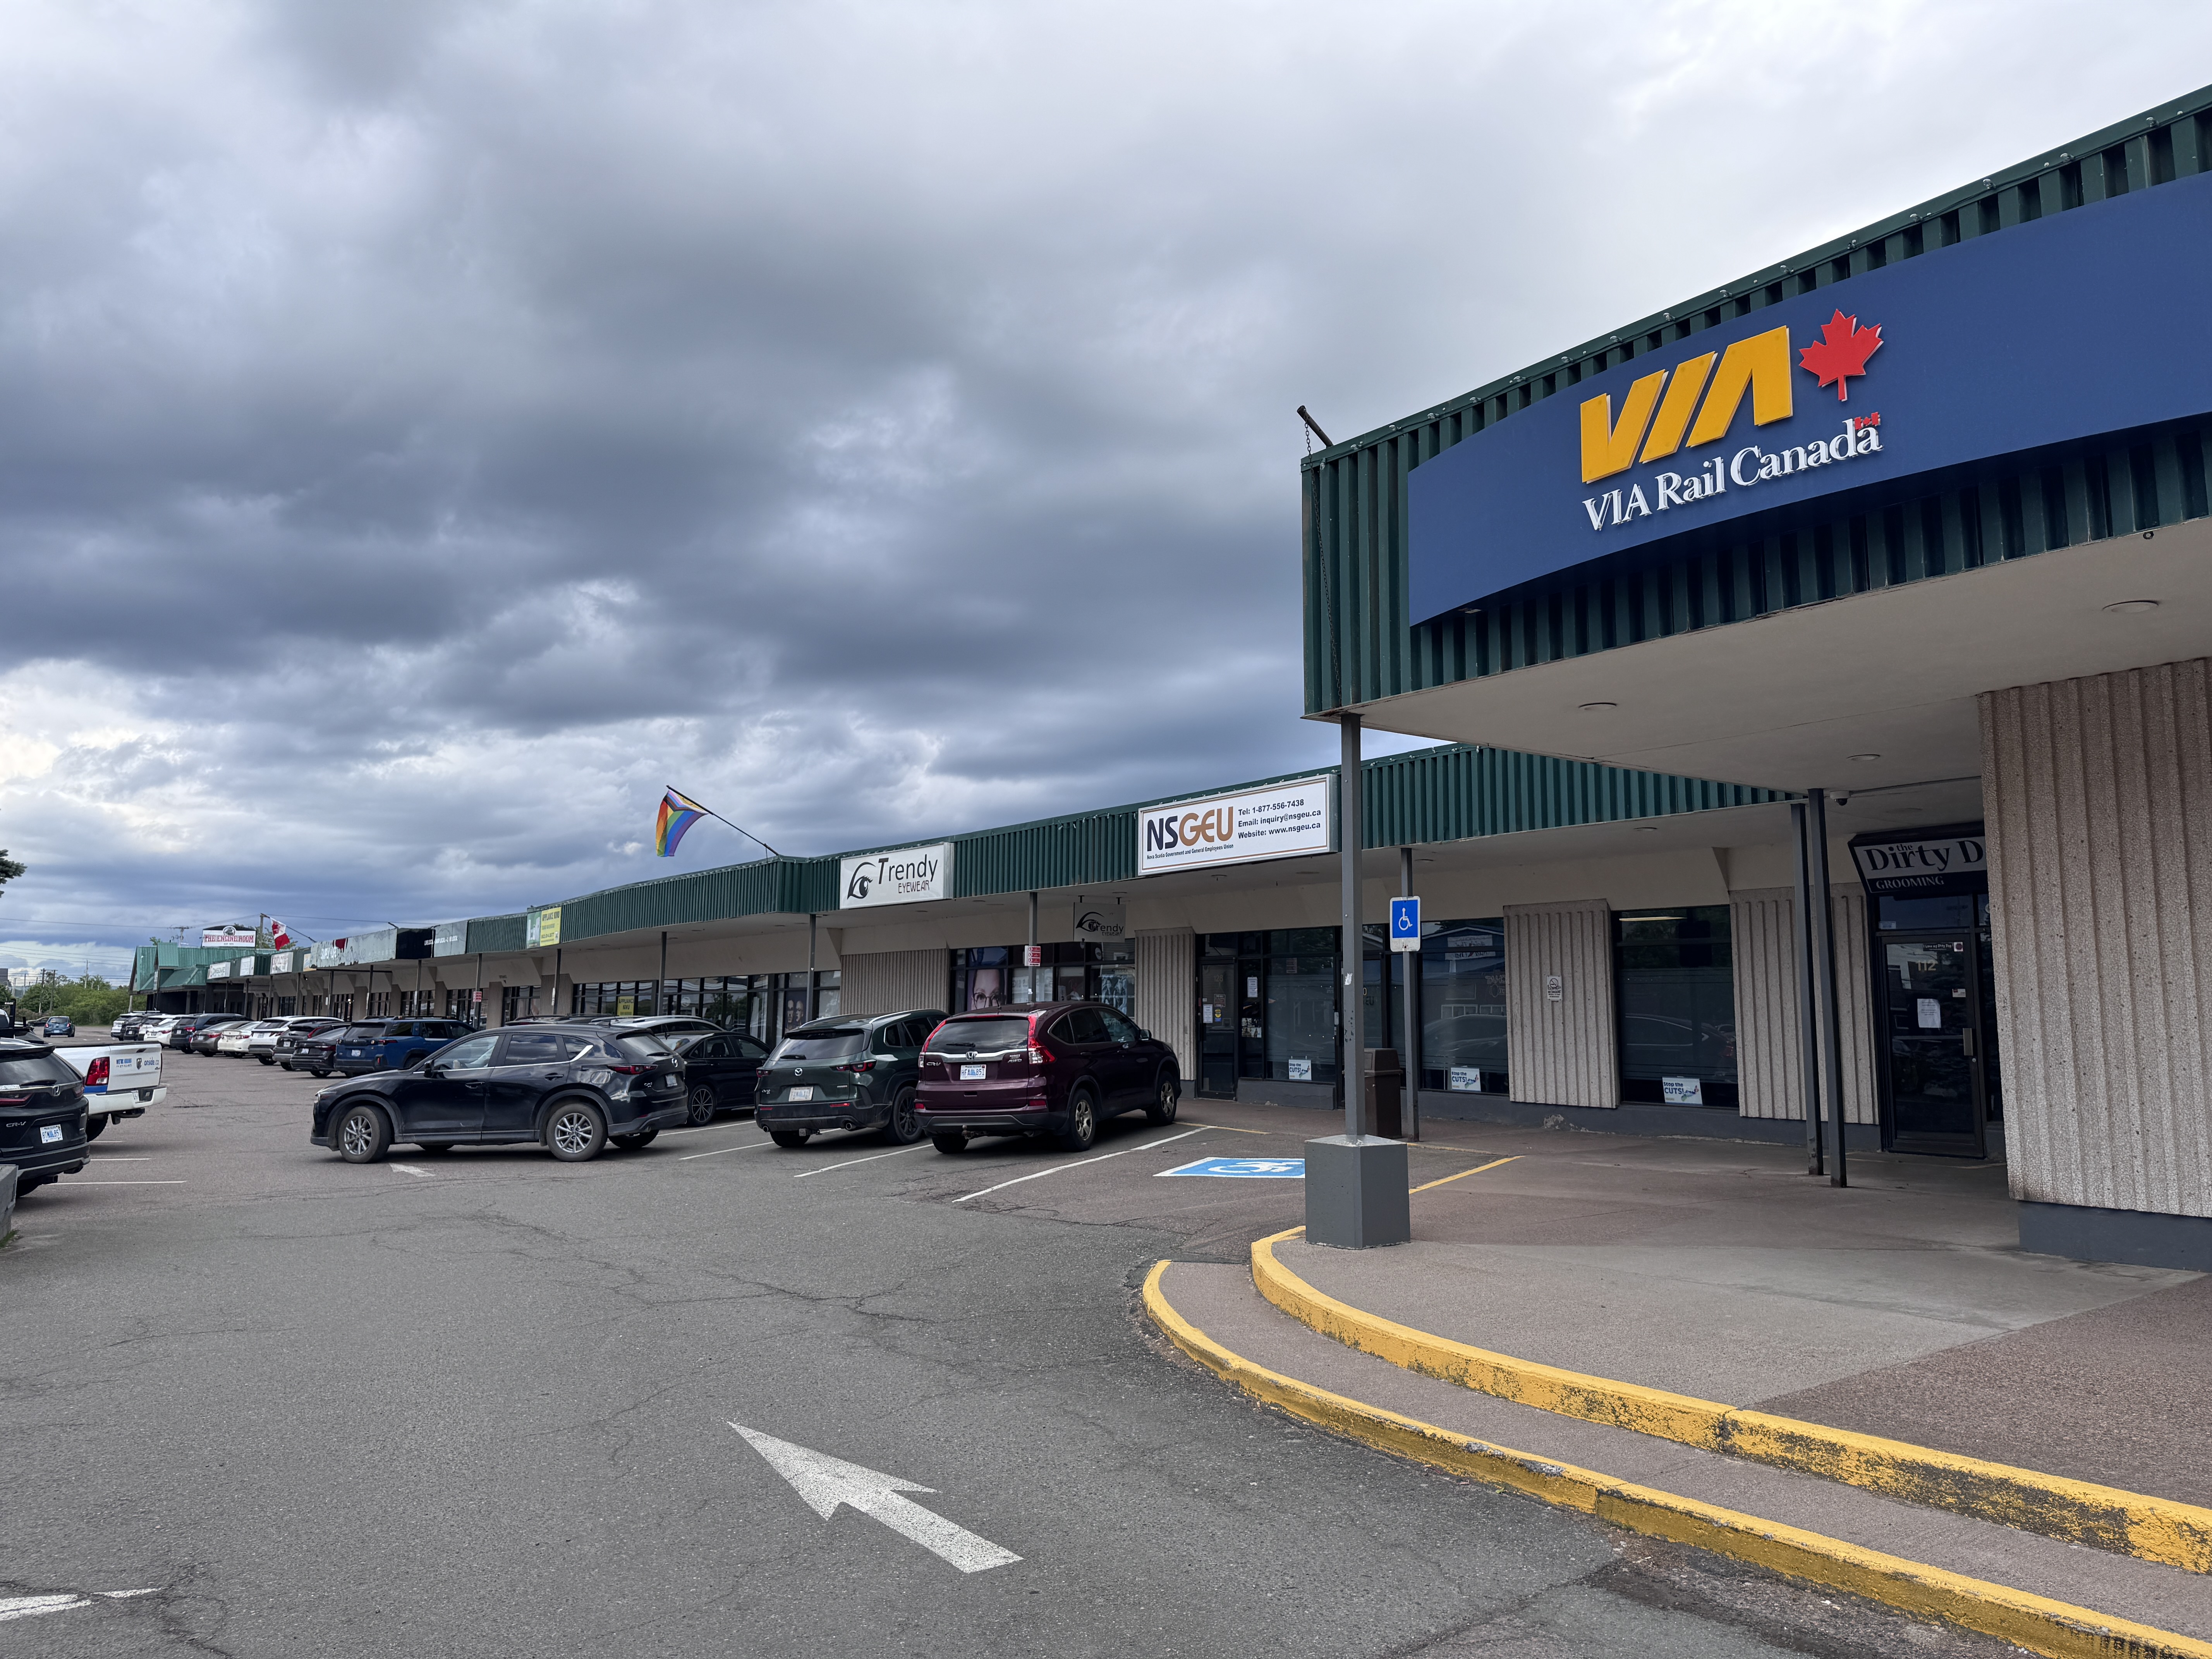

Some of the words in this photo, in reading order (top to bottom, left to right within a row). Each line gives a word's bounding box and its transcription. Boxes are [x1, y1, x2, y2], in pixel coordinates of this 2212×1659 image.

[1580, 325, 1793, 484] VIA
[1582, 483, 1652, 531] VIA
[1655, 456, 1727, 510] Rail
[1730, 418, 1885, 486] Canada
[1252, 799, 1304, 813] 1-877-556-7438
[1238, 819, 1258, 827] Email:
[1260, 810, 1321, 824] inquiry@nsgeu.ca
[1147, 806, 1233, 851] NSGEU
[1238, 830, 1266, 839] Website:
[1268, 823, 1321, 835] www.nsgeu.ca
[1896, 843, 1913, 852] the
[1863, 845, 1950, 871] Dirty
[878, 854, 938, 884] Trendy
[898, 880, 929, 893] EYEWEAR
[1876, 876, 1944, 889] GROOMING
[1090, 922, 1124, 934] Trendy
[1917, 960, 1936, 971] 112
